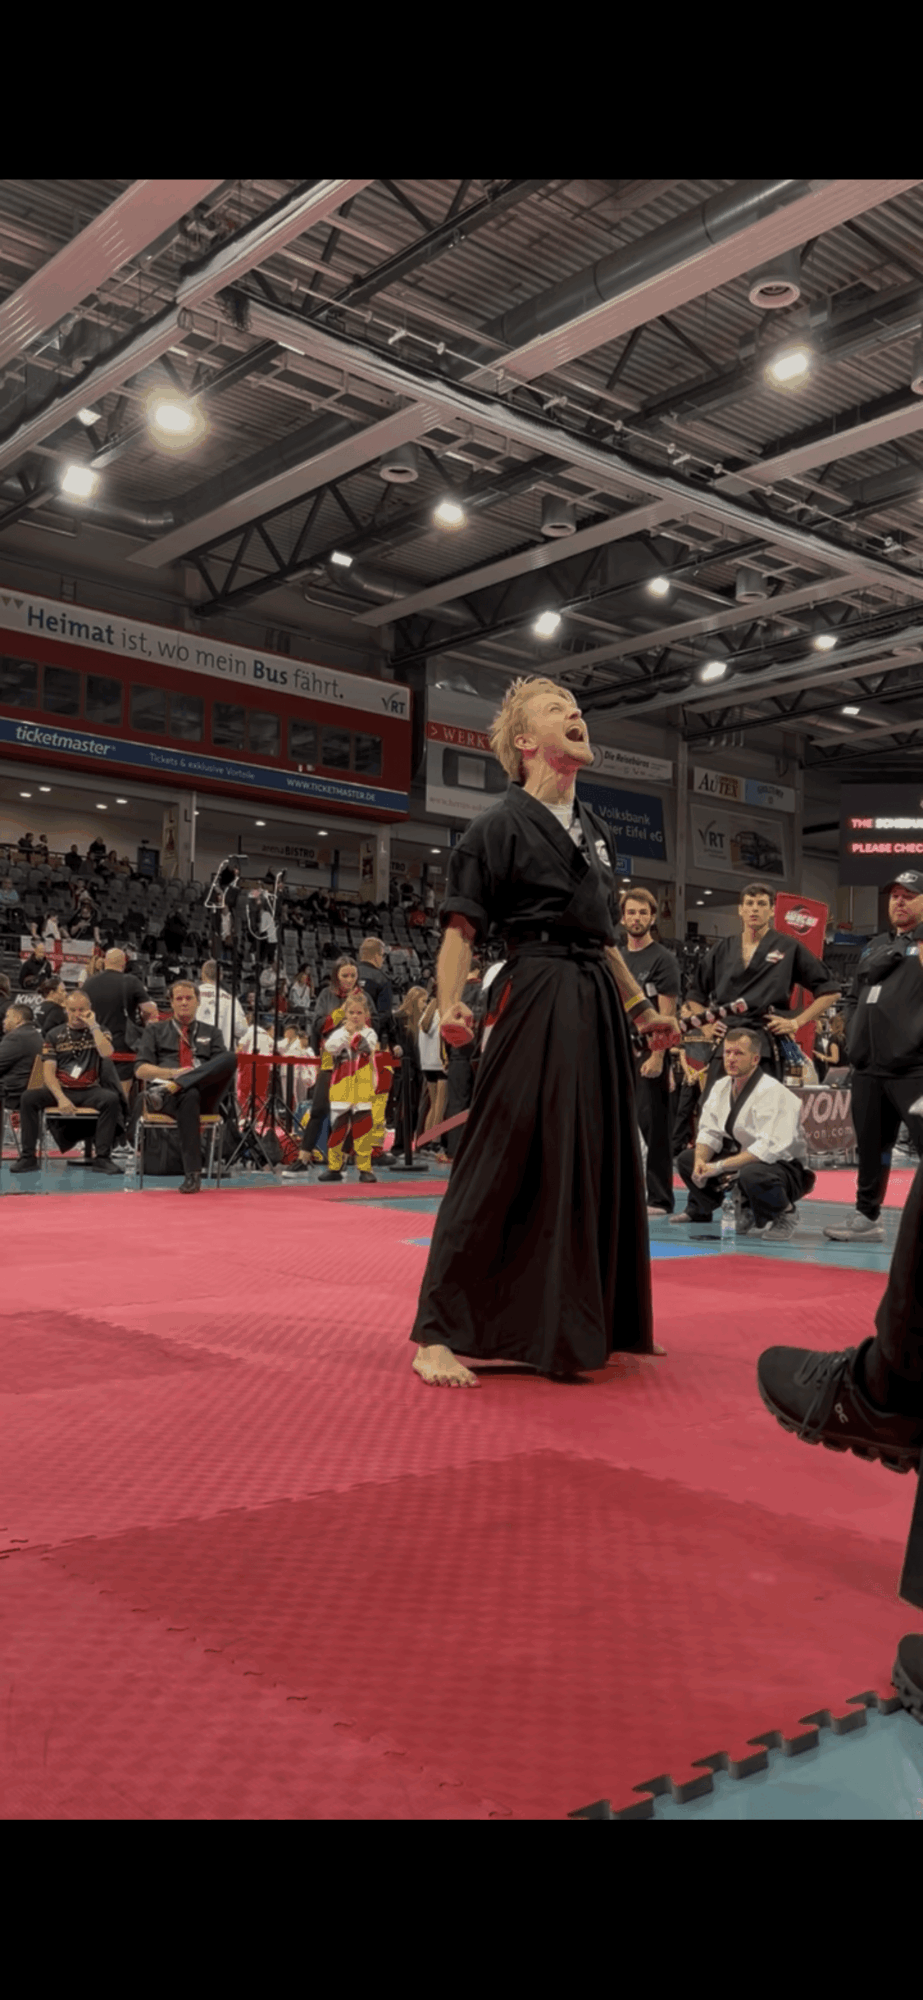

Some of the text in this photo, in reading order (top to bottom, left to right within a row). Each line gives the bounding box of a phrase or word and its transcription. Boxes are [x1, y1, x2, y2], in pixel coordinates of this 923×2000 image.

[27, 605, 344, 700] Heimat ist, wo mein Bus fährt.
[15, 725, 111, 756] ticketmaster
[442, 726, 489, 750] WERK
[148, 751, 179, 767] Tickets
[180, 757, 187, 768] &
[286, 777, 376, 802] WWW.TICKETMASTER.DE
[598, 805, 651, 826] Volksbank
[851, 817, 873, 829] THE
[625, 824, 648, 840] Eifel
[649, 830, 664, 843] eG
[852, 843, 892, 854] PLEASE
[15, 993, 45, 1005] KWO
